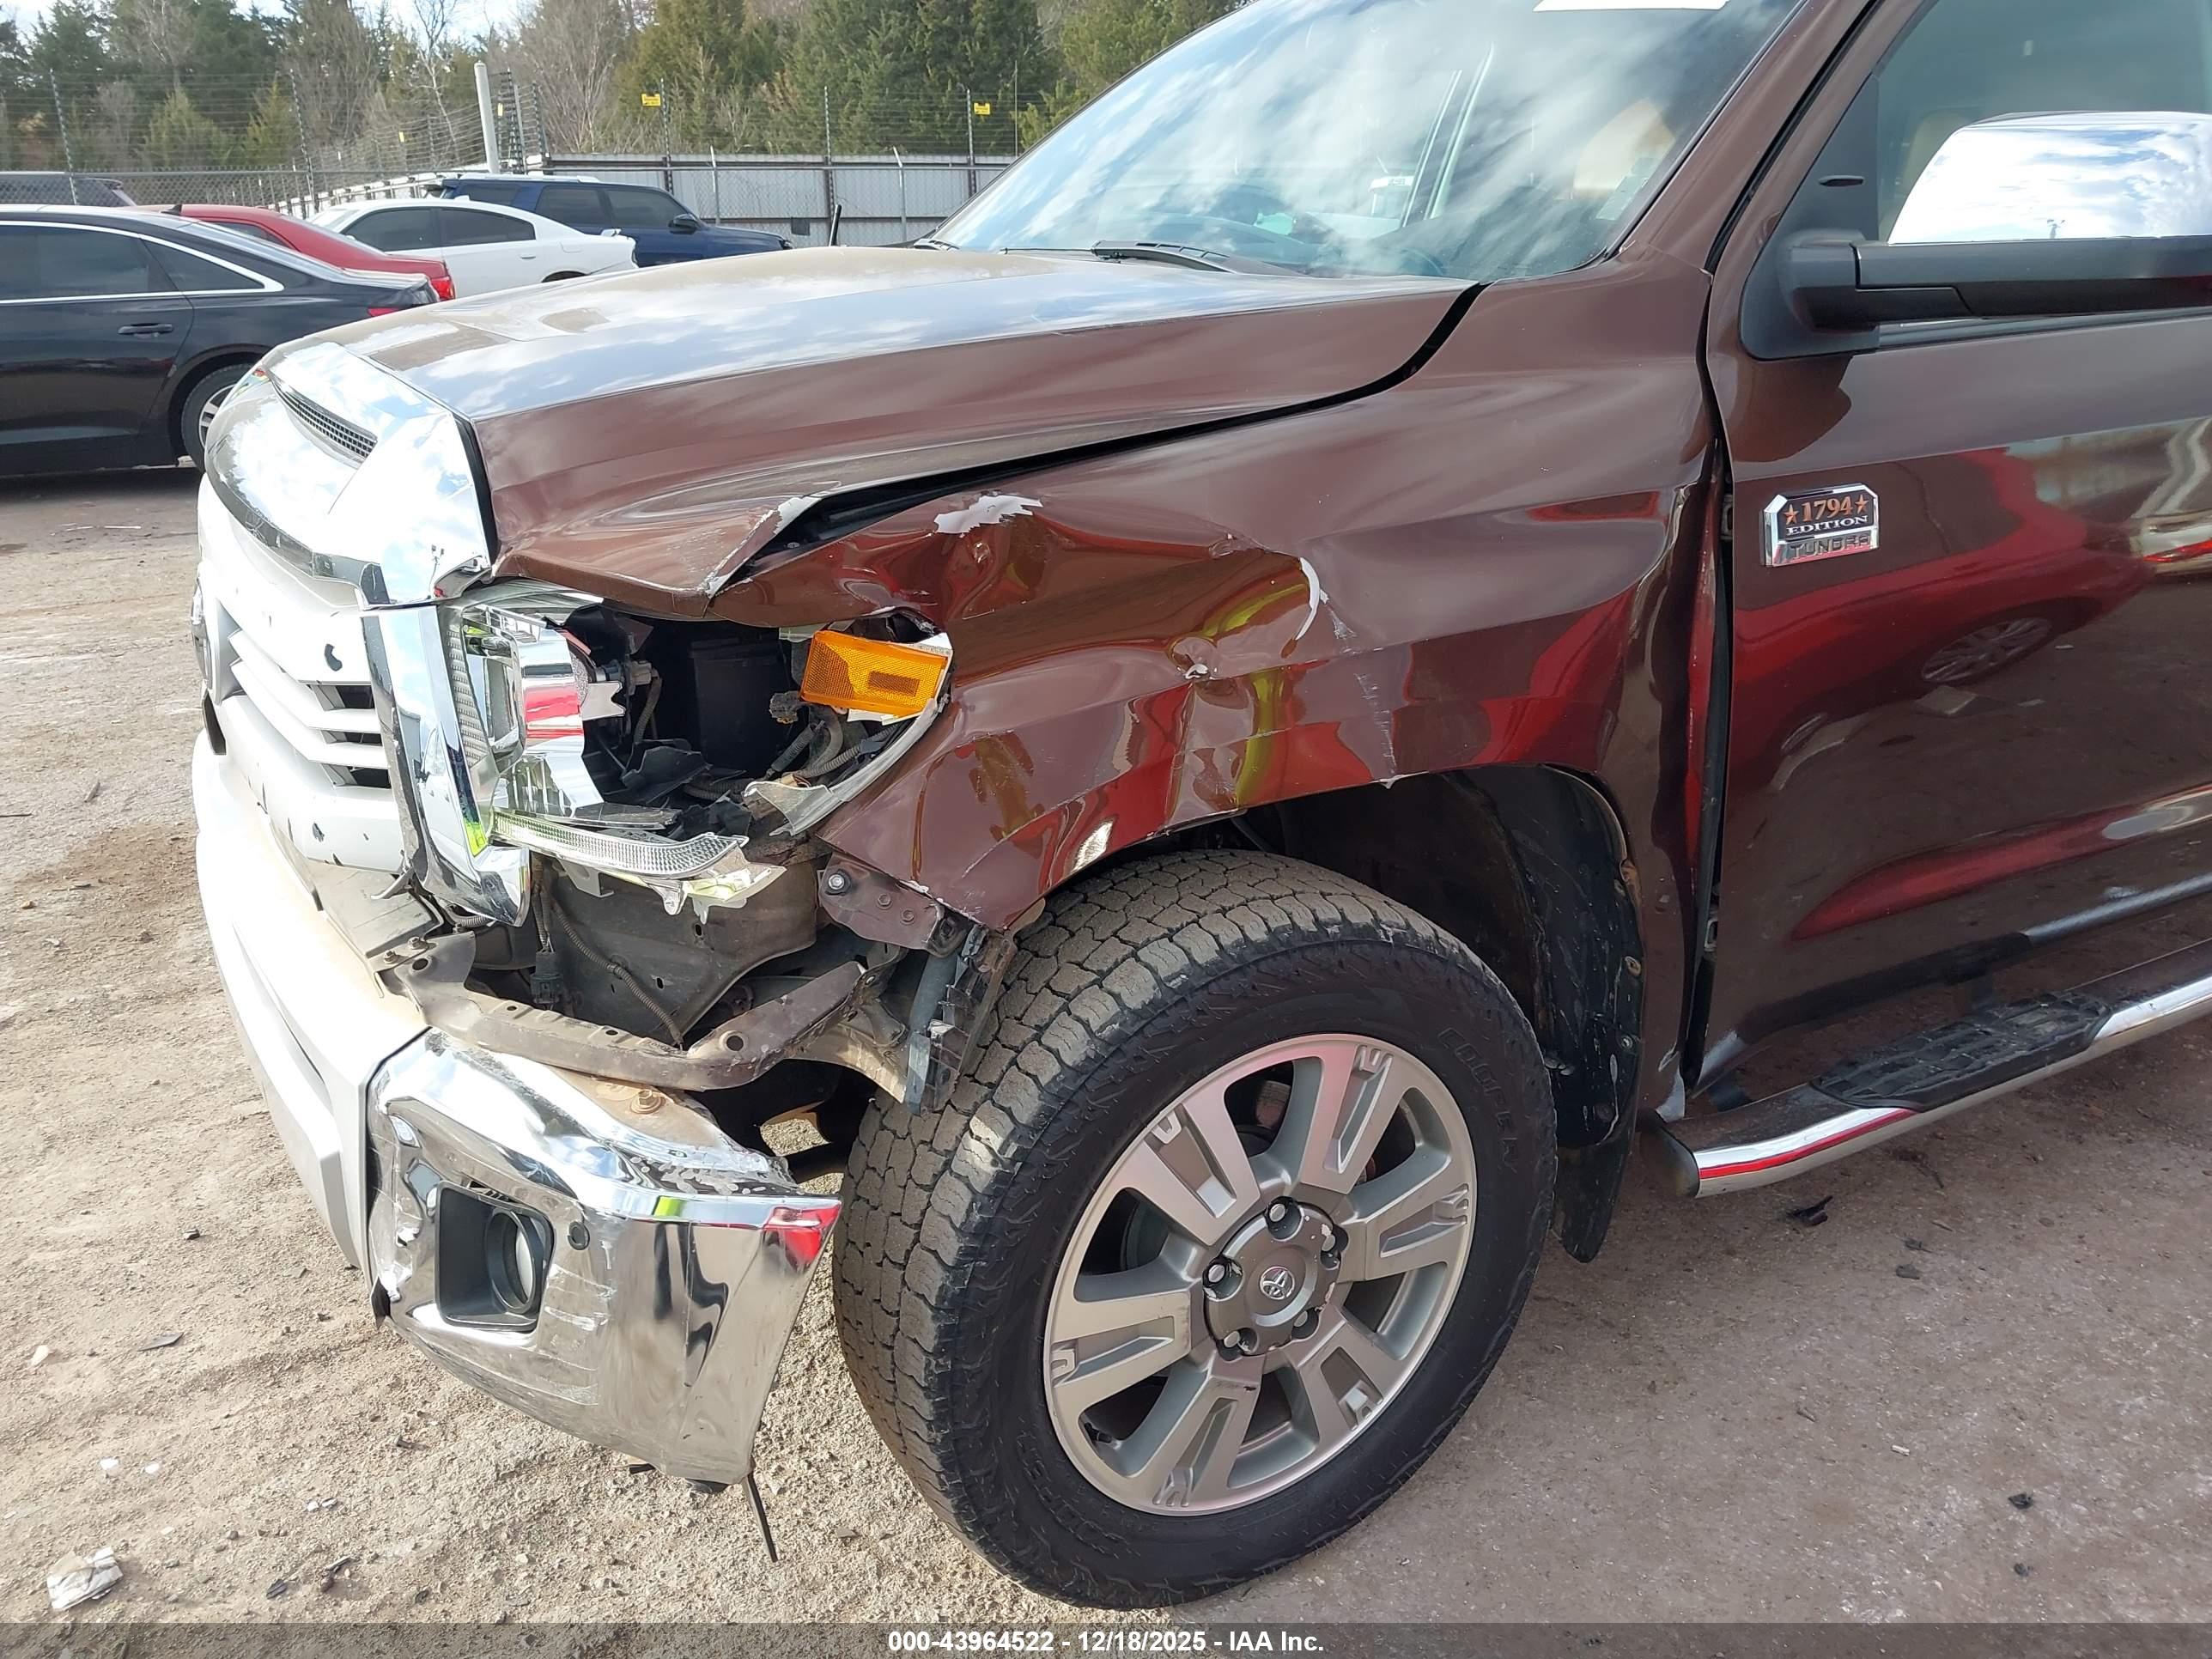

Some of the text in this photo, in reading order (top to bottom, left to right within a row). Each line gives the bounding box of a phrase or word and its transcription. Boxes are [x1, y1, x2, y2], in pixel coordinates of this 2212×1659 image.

[1802, 495, 1854, 522] 1794
[1786, 515, 1869, 536] EDITION
[1790, 535, 1870, 559] TUNDRA
